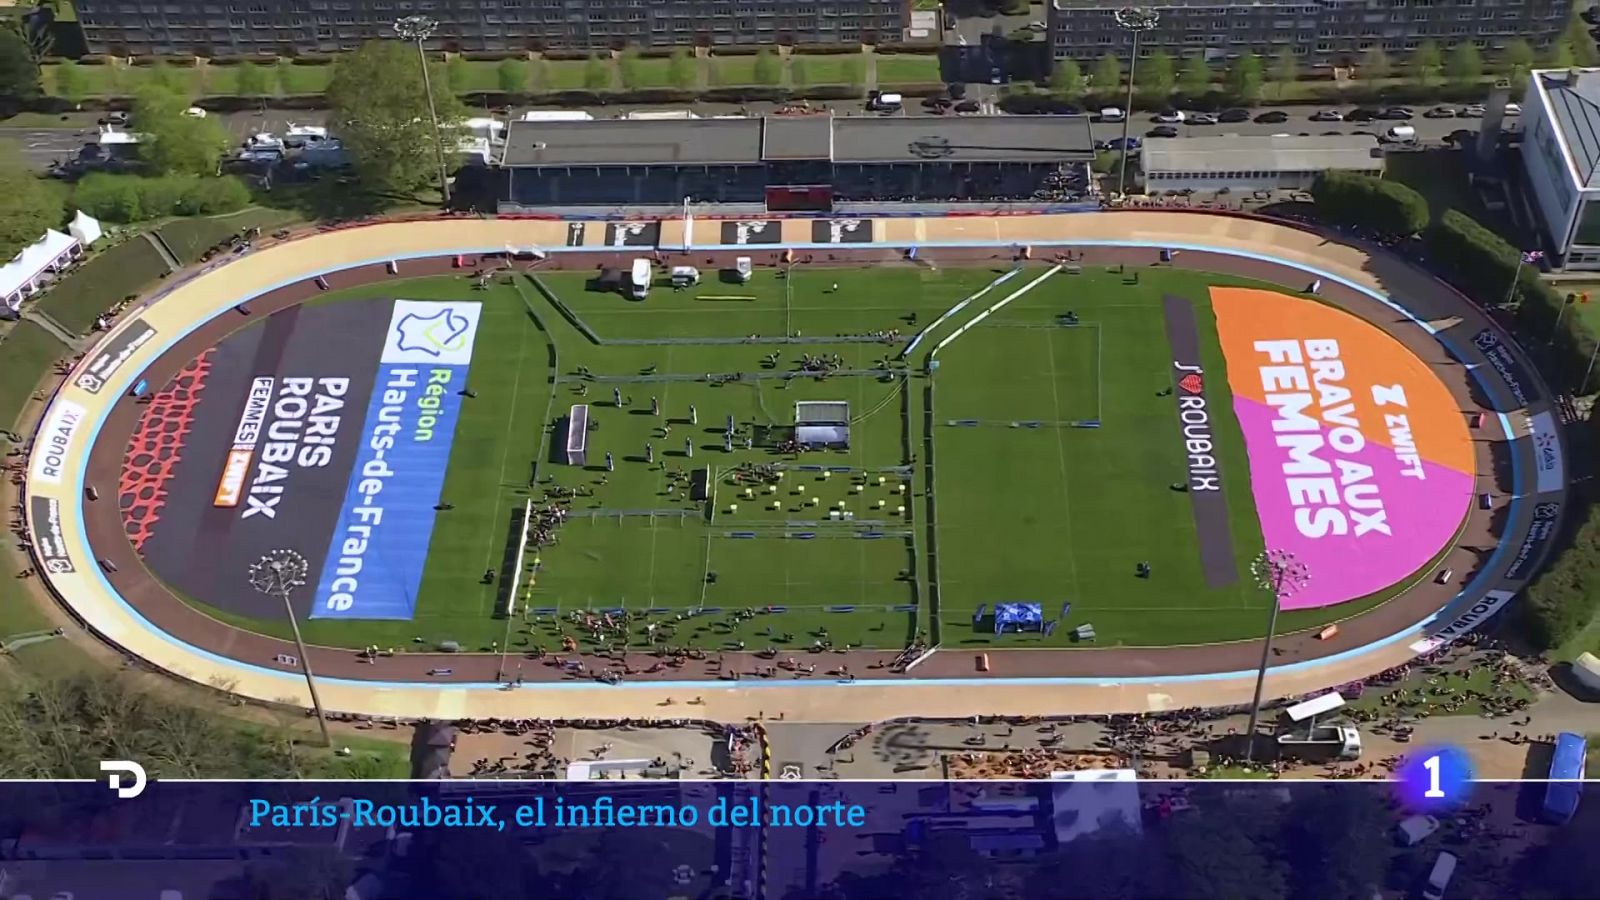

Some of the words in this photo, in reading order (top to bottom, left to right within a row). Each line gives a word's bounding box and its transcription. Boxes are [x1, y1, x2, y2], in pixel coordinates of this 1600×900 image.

[41, 410, 82, 477] ROUBAIX
[237, 377, 273, 443] FEMMES
[241, 376, 314, 519] ROUBAIX
[297, 376, 350, 467] PARIS
[413, 369, 453, 442] Région
[1178, 395, 1220, 491] ROUBAIX
[1253, 339, 1349, 539] FEMMES
[1304, 339, 1366, 454] BRAVO
[1335, 458, 1393, 538] AUX
[1384, 413, 1426, 480] ZWIFT
[326, 368, 419, 611] Hauts-de-France
